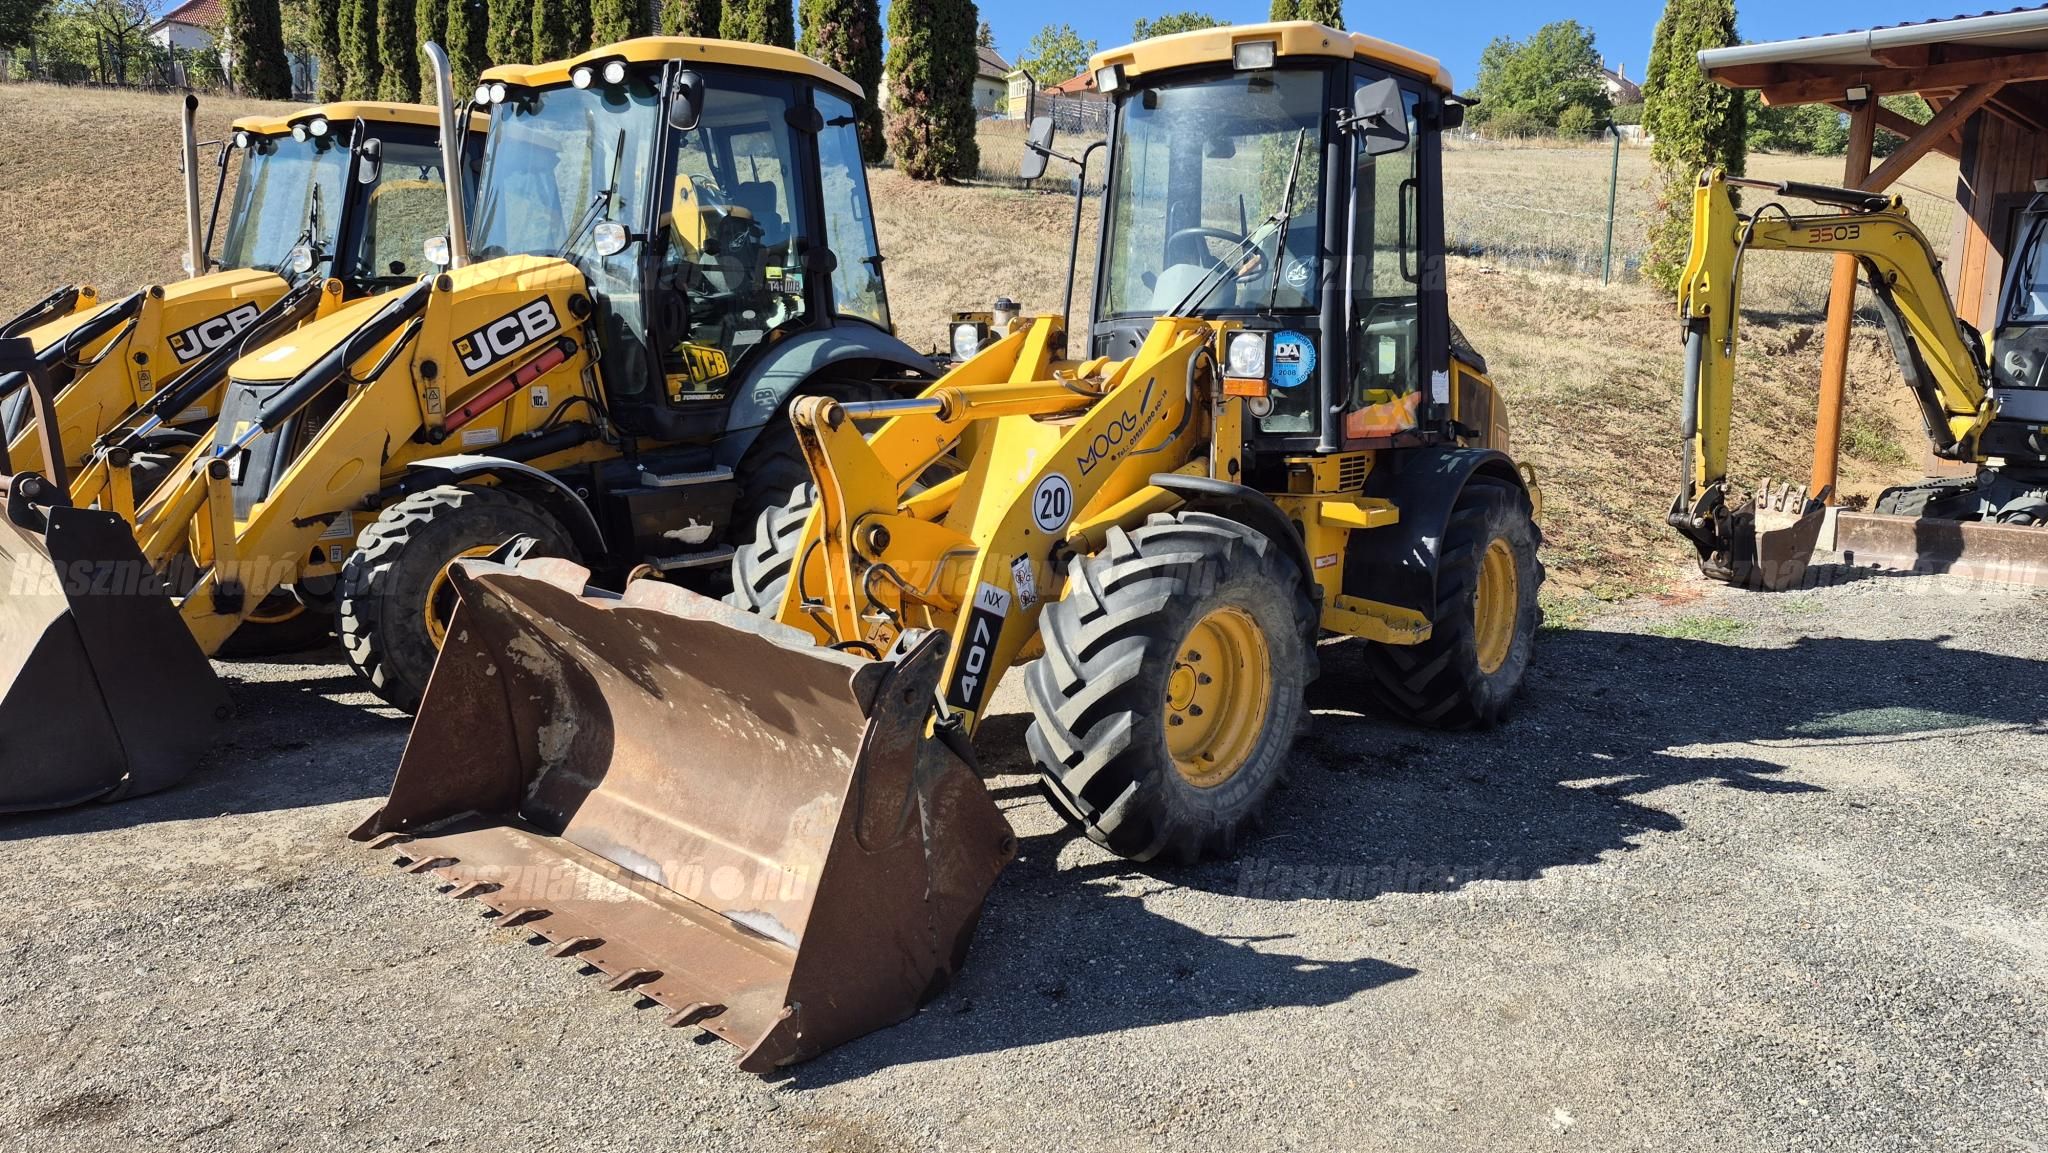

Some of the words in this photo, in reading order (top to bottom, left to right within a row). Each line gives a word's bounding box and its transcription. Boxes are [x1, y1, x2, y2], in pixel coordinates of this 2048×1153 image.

[1808, 225, 1860, 244] 3503
[176, 305, 257, 360] JCB
[463, 300, 557, 371] JCB
[691, 348, 728, 382] JCB
[1077, 410, 1137, 476] MOOG
[1040, 487, 1066, 520] 20
[983, 590, 1004, 608] NX
[961, 617, 991, 703] 407
